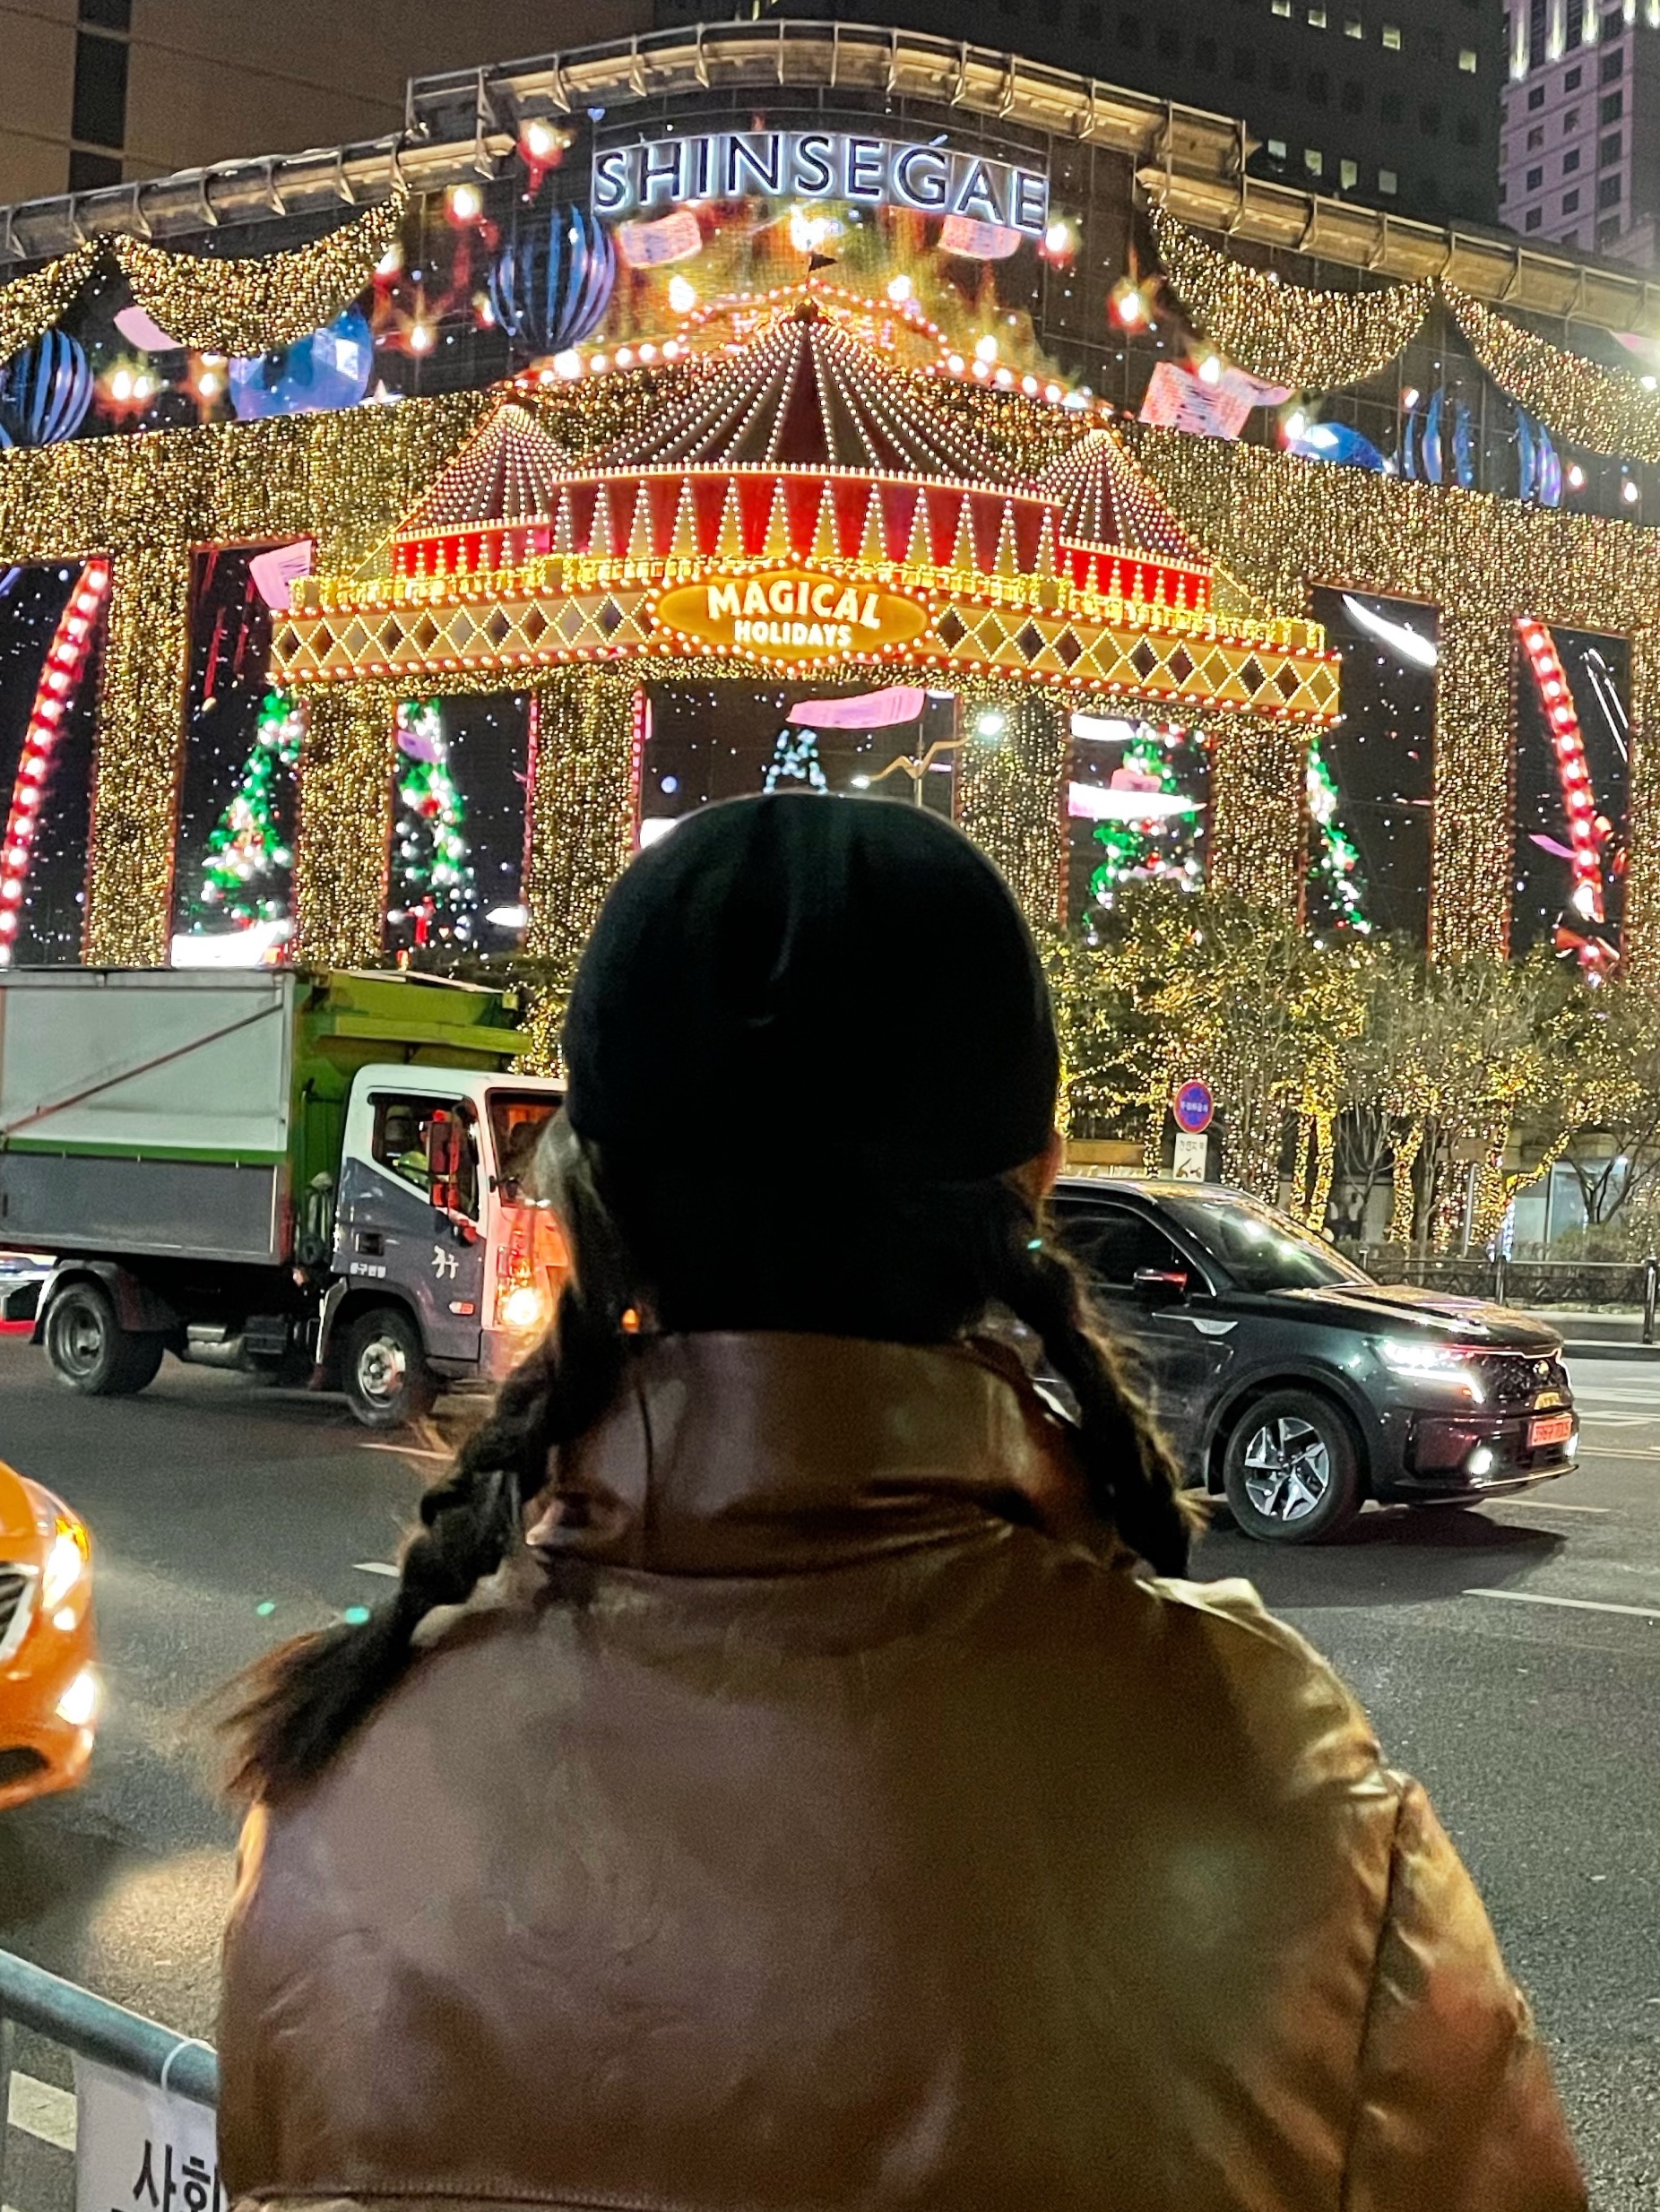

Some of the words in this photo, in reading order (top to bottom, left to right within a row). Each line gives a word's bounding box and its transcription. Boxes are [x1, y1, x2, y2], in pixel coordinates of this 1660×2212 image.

[593, 133, 1049, 235] SHINSEGAE
[706, 579, 881, 629] MAGICAL
[734, 619, 852, 647] HOLIDAYS
